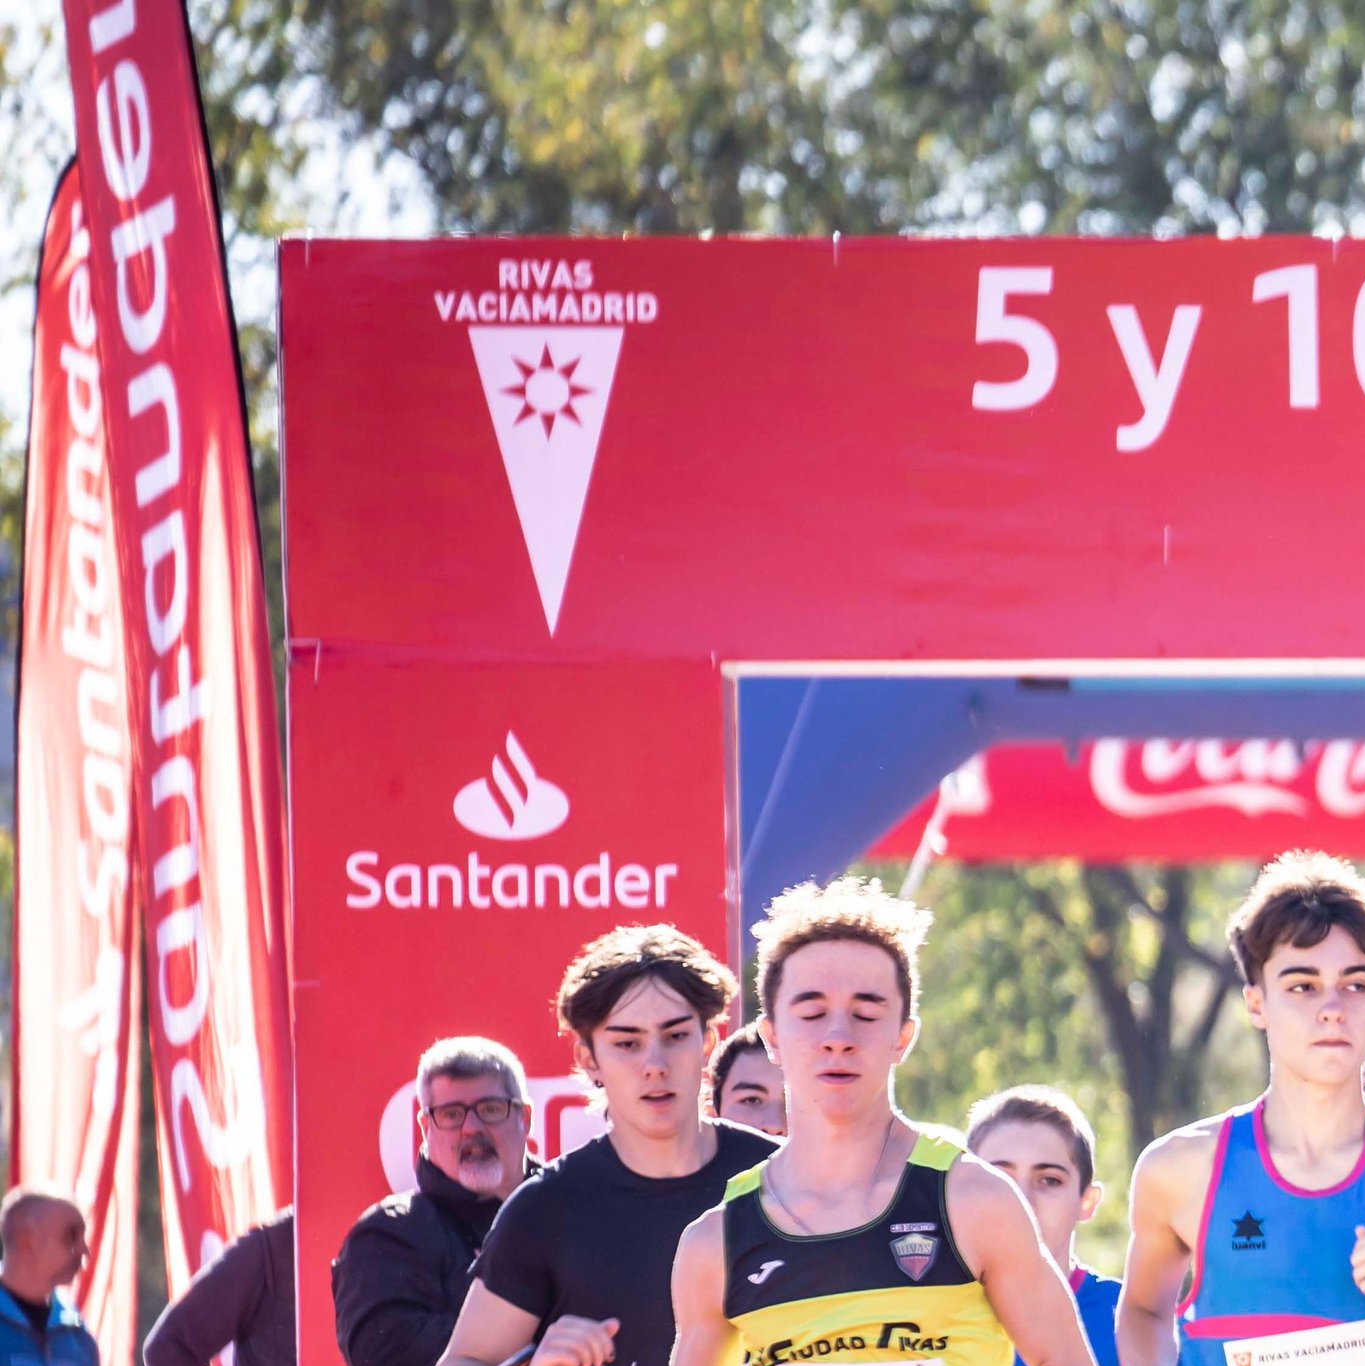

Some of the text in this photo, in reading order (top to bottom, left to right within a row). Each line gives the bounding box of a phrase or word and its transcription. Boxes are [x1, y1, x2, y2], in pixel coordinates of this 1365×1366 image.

[498, 260, 594, 290] RIVAS
[434, 292, 658, 323] VACIAMADRID
[971, 267, 1058, 411] 5
[1106, 305, 1202, 453] y
[345, 851, 678, 909] Santander
[1258, 1351, 1291, 1363] RIVAS
